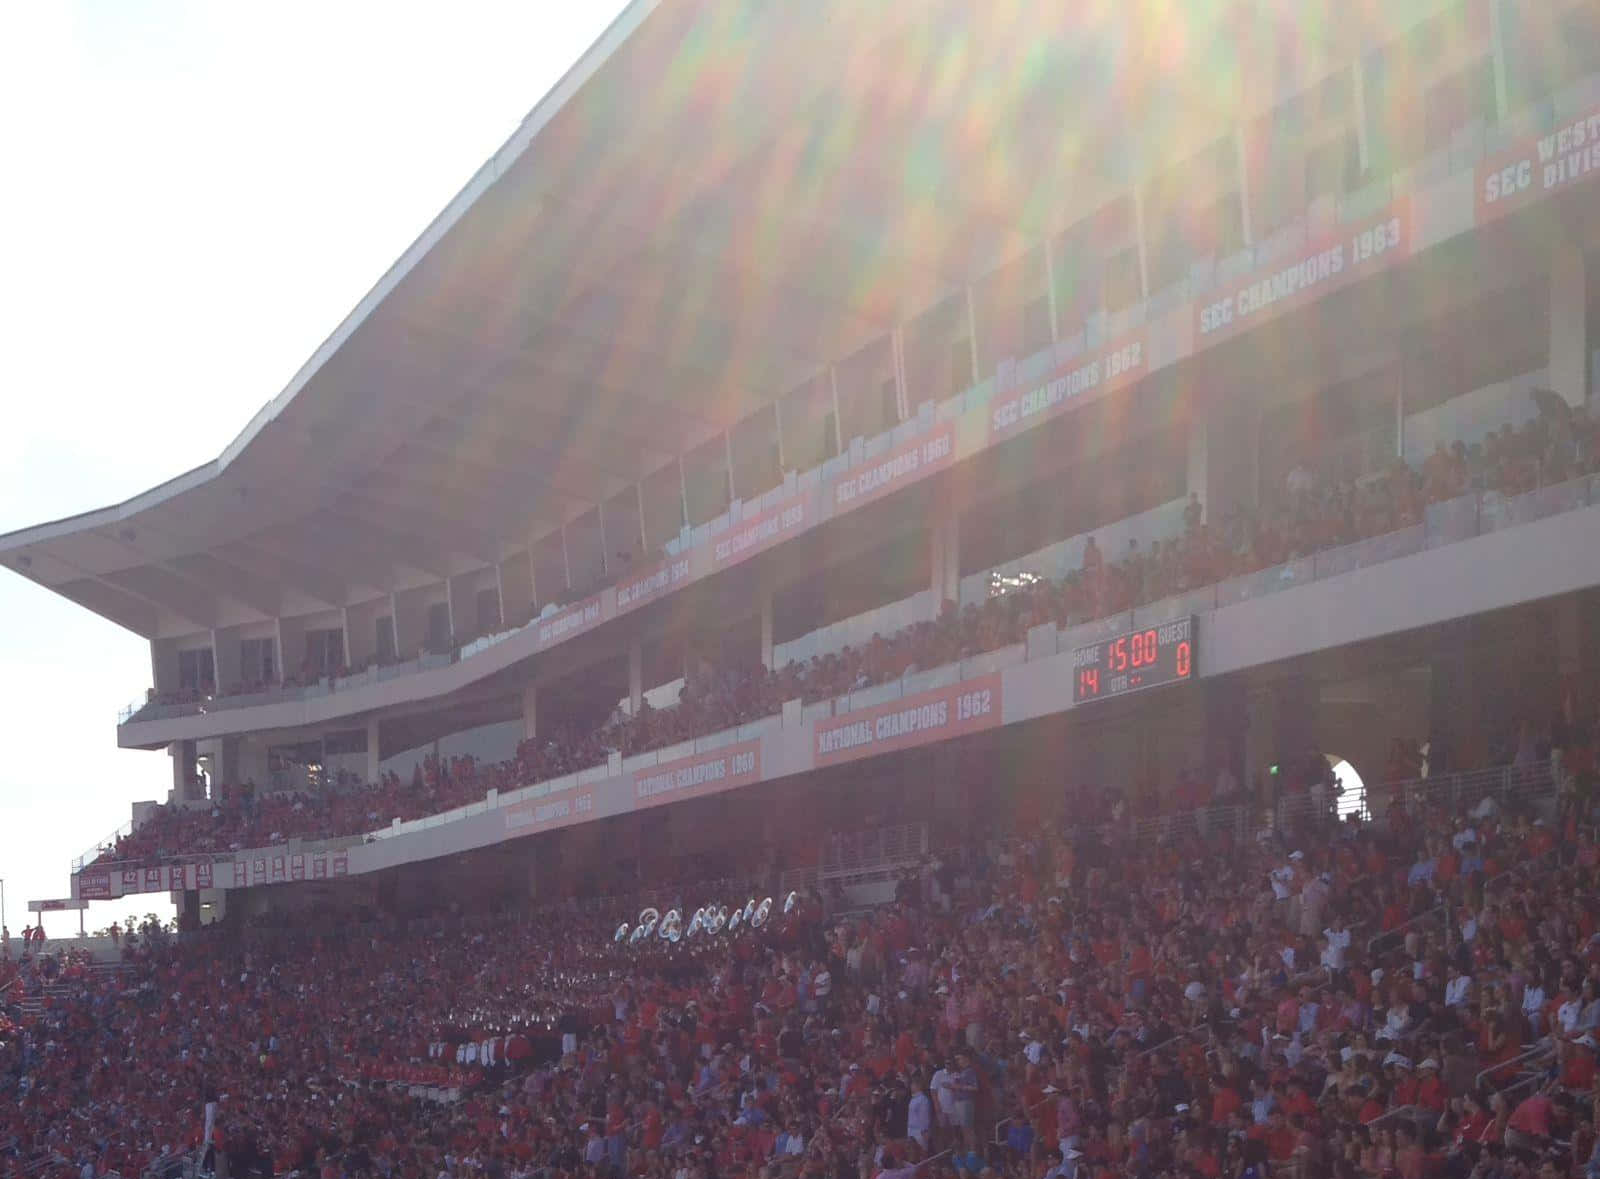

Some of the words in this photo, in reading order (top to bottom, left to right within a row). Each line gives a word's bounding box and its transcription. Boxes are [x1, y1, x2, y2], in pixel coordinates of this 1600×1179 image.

[1484, 160, 1530, 203] SEC
[1201, 298, 1232, 333] SEC
[1237, 244, 1344, 316] CHAMPIONS
[993, 401, 1017, 431] SEC
[1021, 361, 1099, 417] CHAMPIONS
[1159, 620, 1191, 646] GUEST
[1073, 646, 1100, 668] HOME
[1177, 641, 1191, 677] 0
[1080, 669, 1099, 697] 14
[819, 721, 873, 753] NATIONAL
[876, 701, 948, 740] CHAMPIONS
[957, 689, 991, 721] 1962
